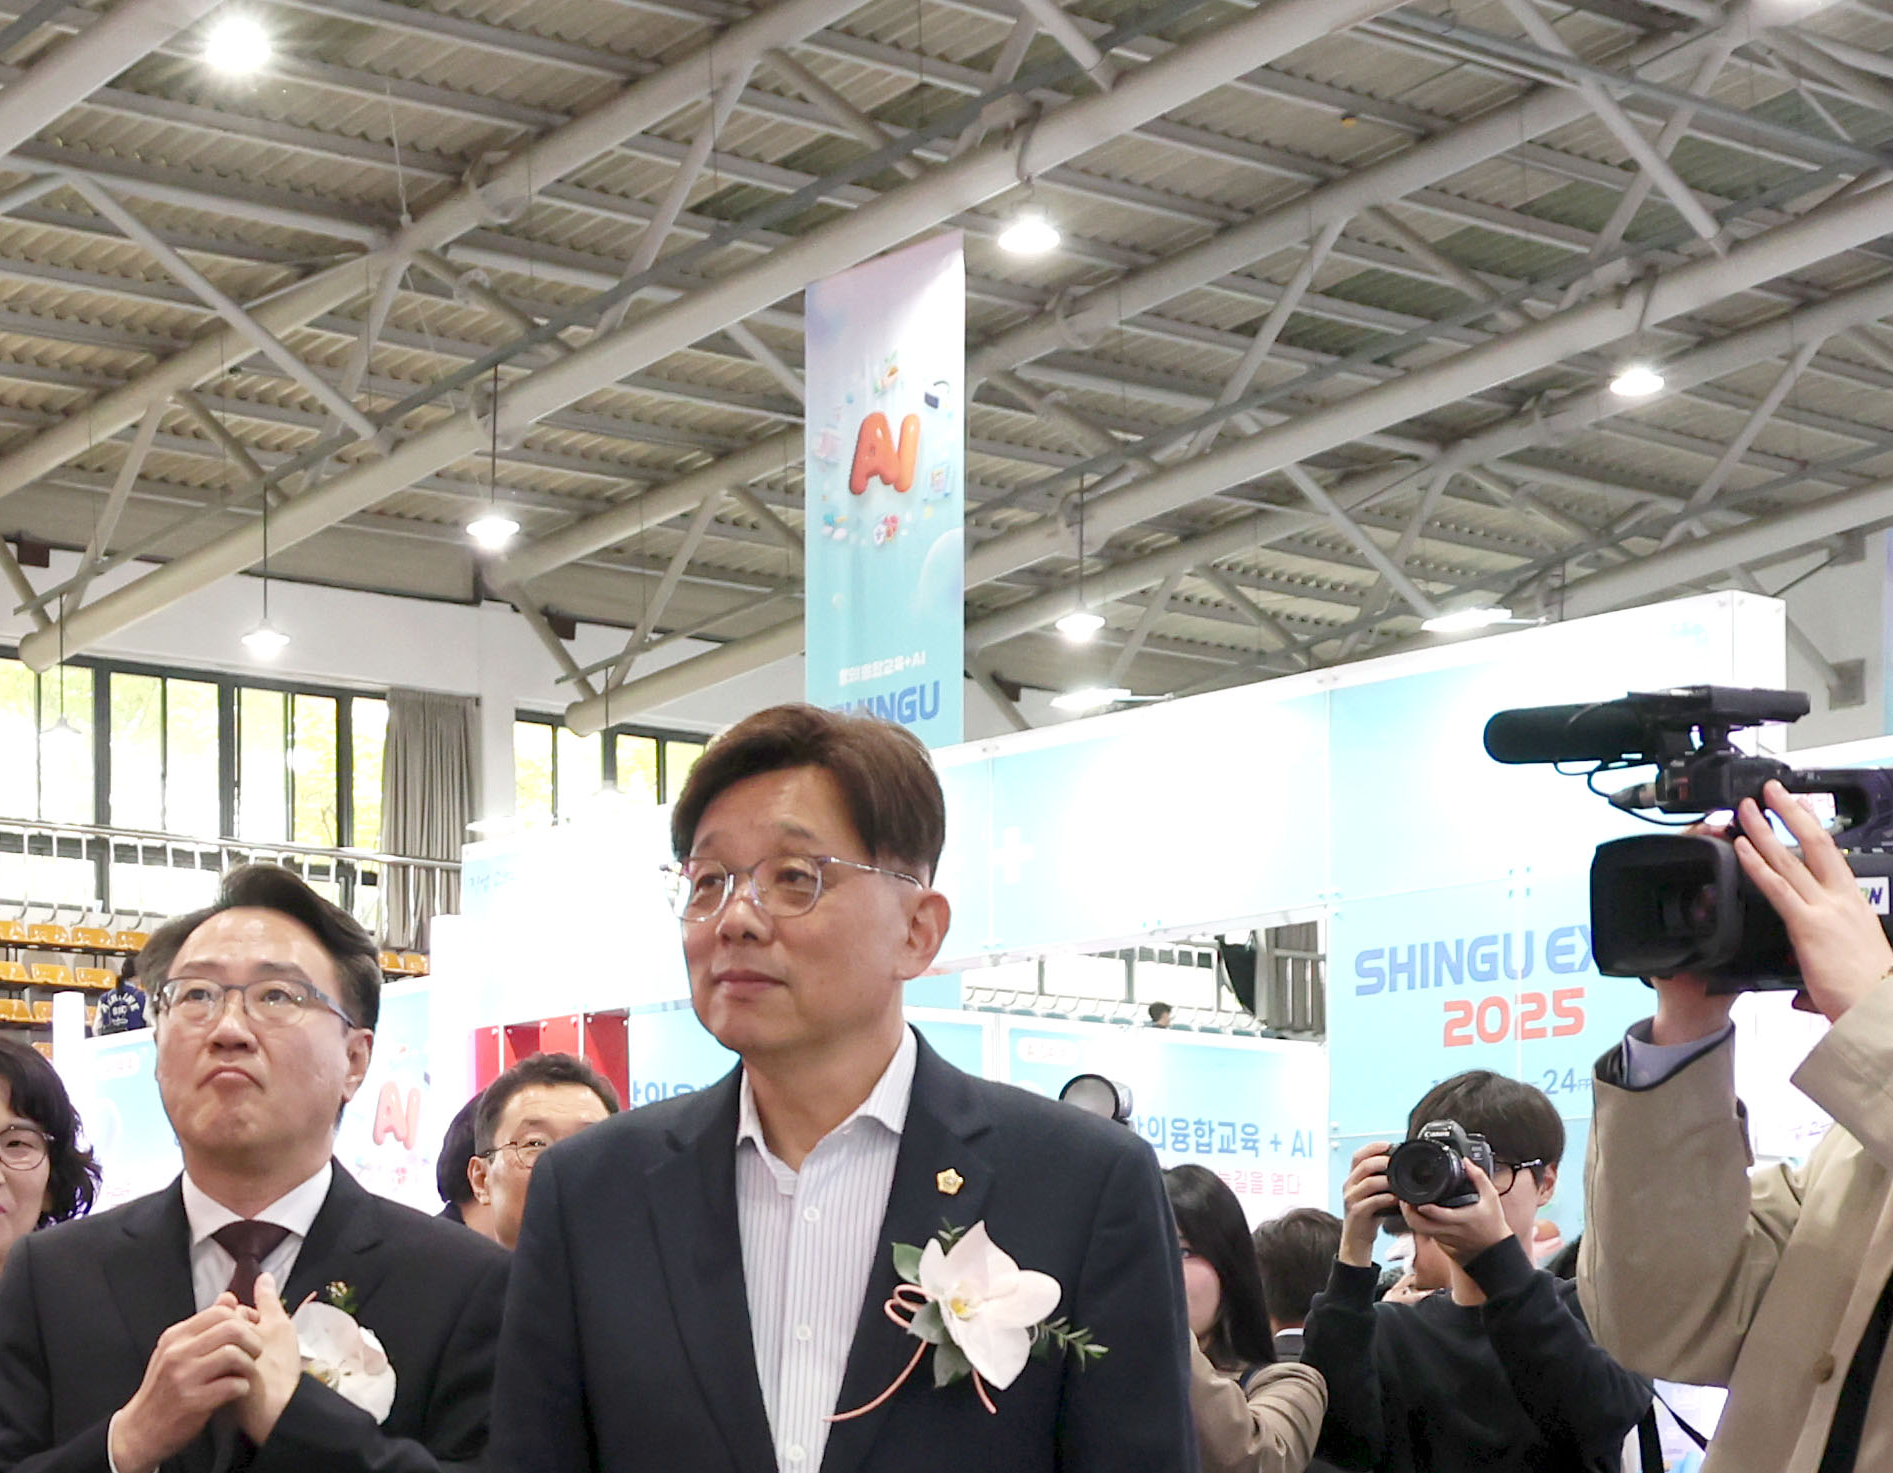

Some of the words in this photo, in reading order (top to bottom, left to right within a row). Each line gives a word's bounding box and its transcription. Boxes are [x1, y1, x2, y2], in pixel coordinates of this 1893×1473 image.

[848, 410, 921, 495] AI
[1354, 930, 1534, 997] SHINGU
[1443, 986, 1586, 1048] 2025
[372, 1081, 422, 1151] AI
[1135, 1115, 1260, 1158] 의융합교육
[1290, 1129, 1313, 1158] AI
